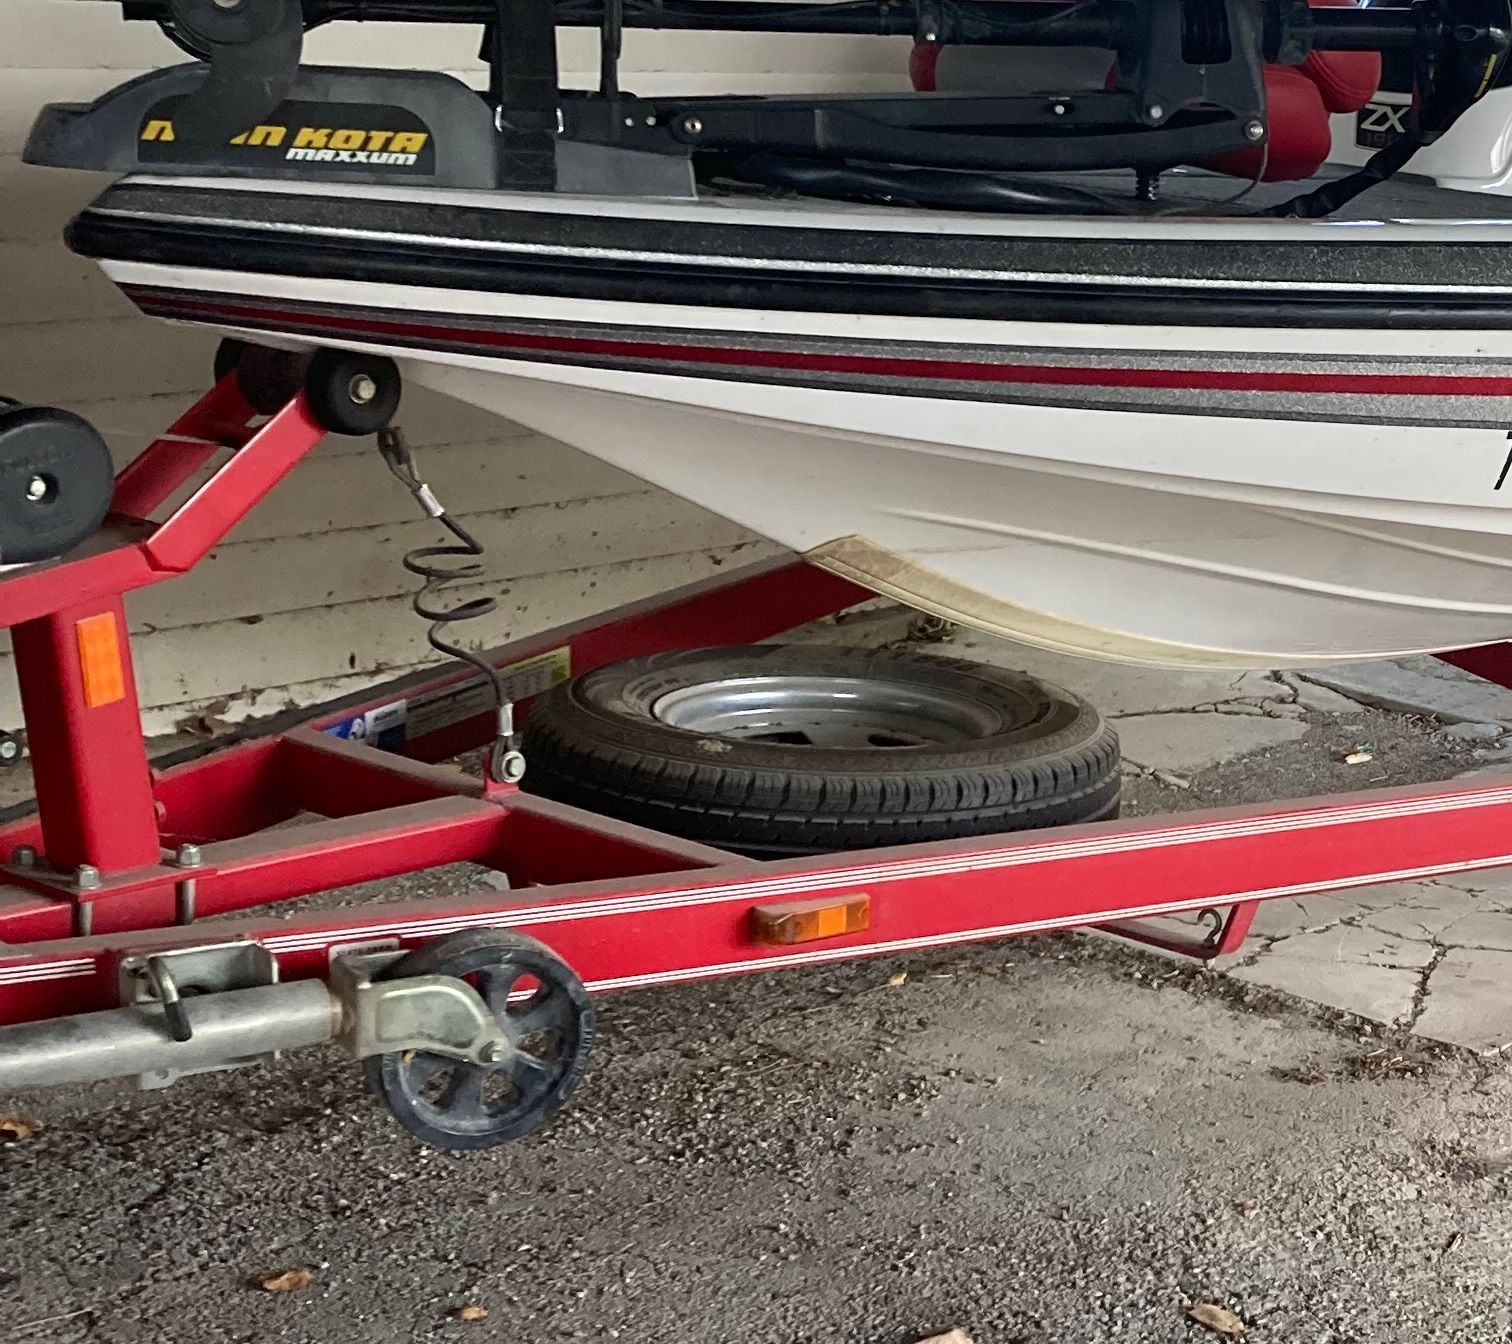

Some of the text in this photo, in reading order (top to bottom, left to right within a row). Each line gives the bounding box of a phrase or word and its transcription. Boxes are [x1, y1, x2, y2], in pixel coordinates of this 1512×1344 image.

[1361, 103, 1411, 132] ZX
[292, 127, 428, 153] KOTA
[285, 148, 417, 165] MAXXUM
